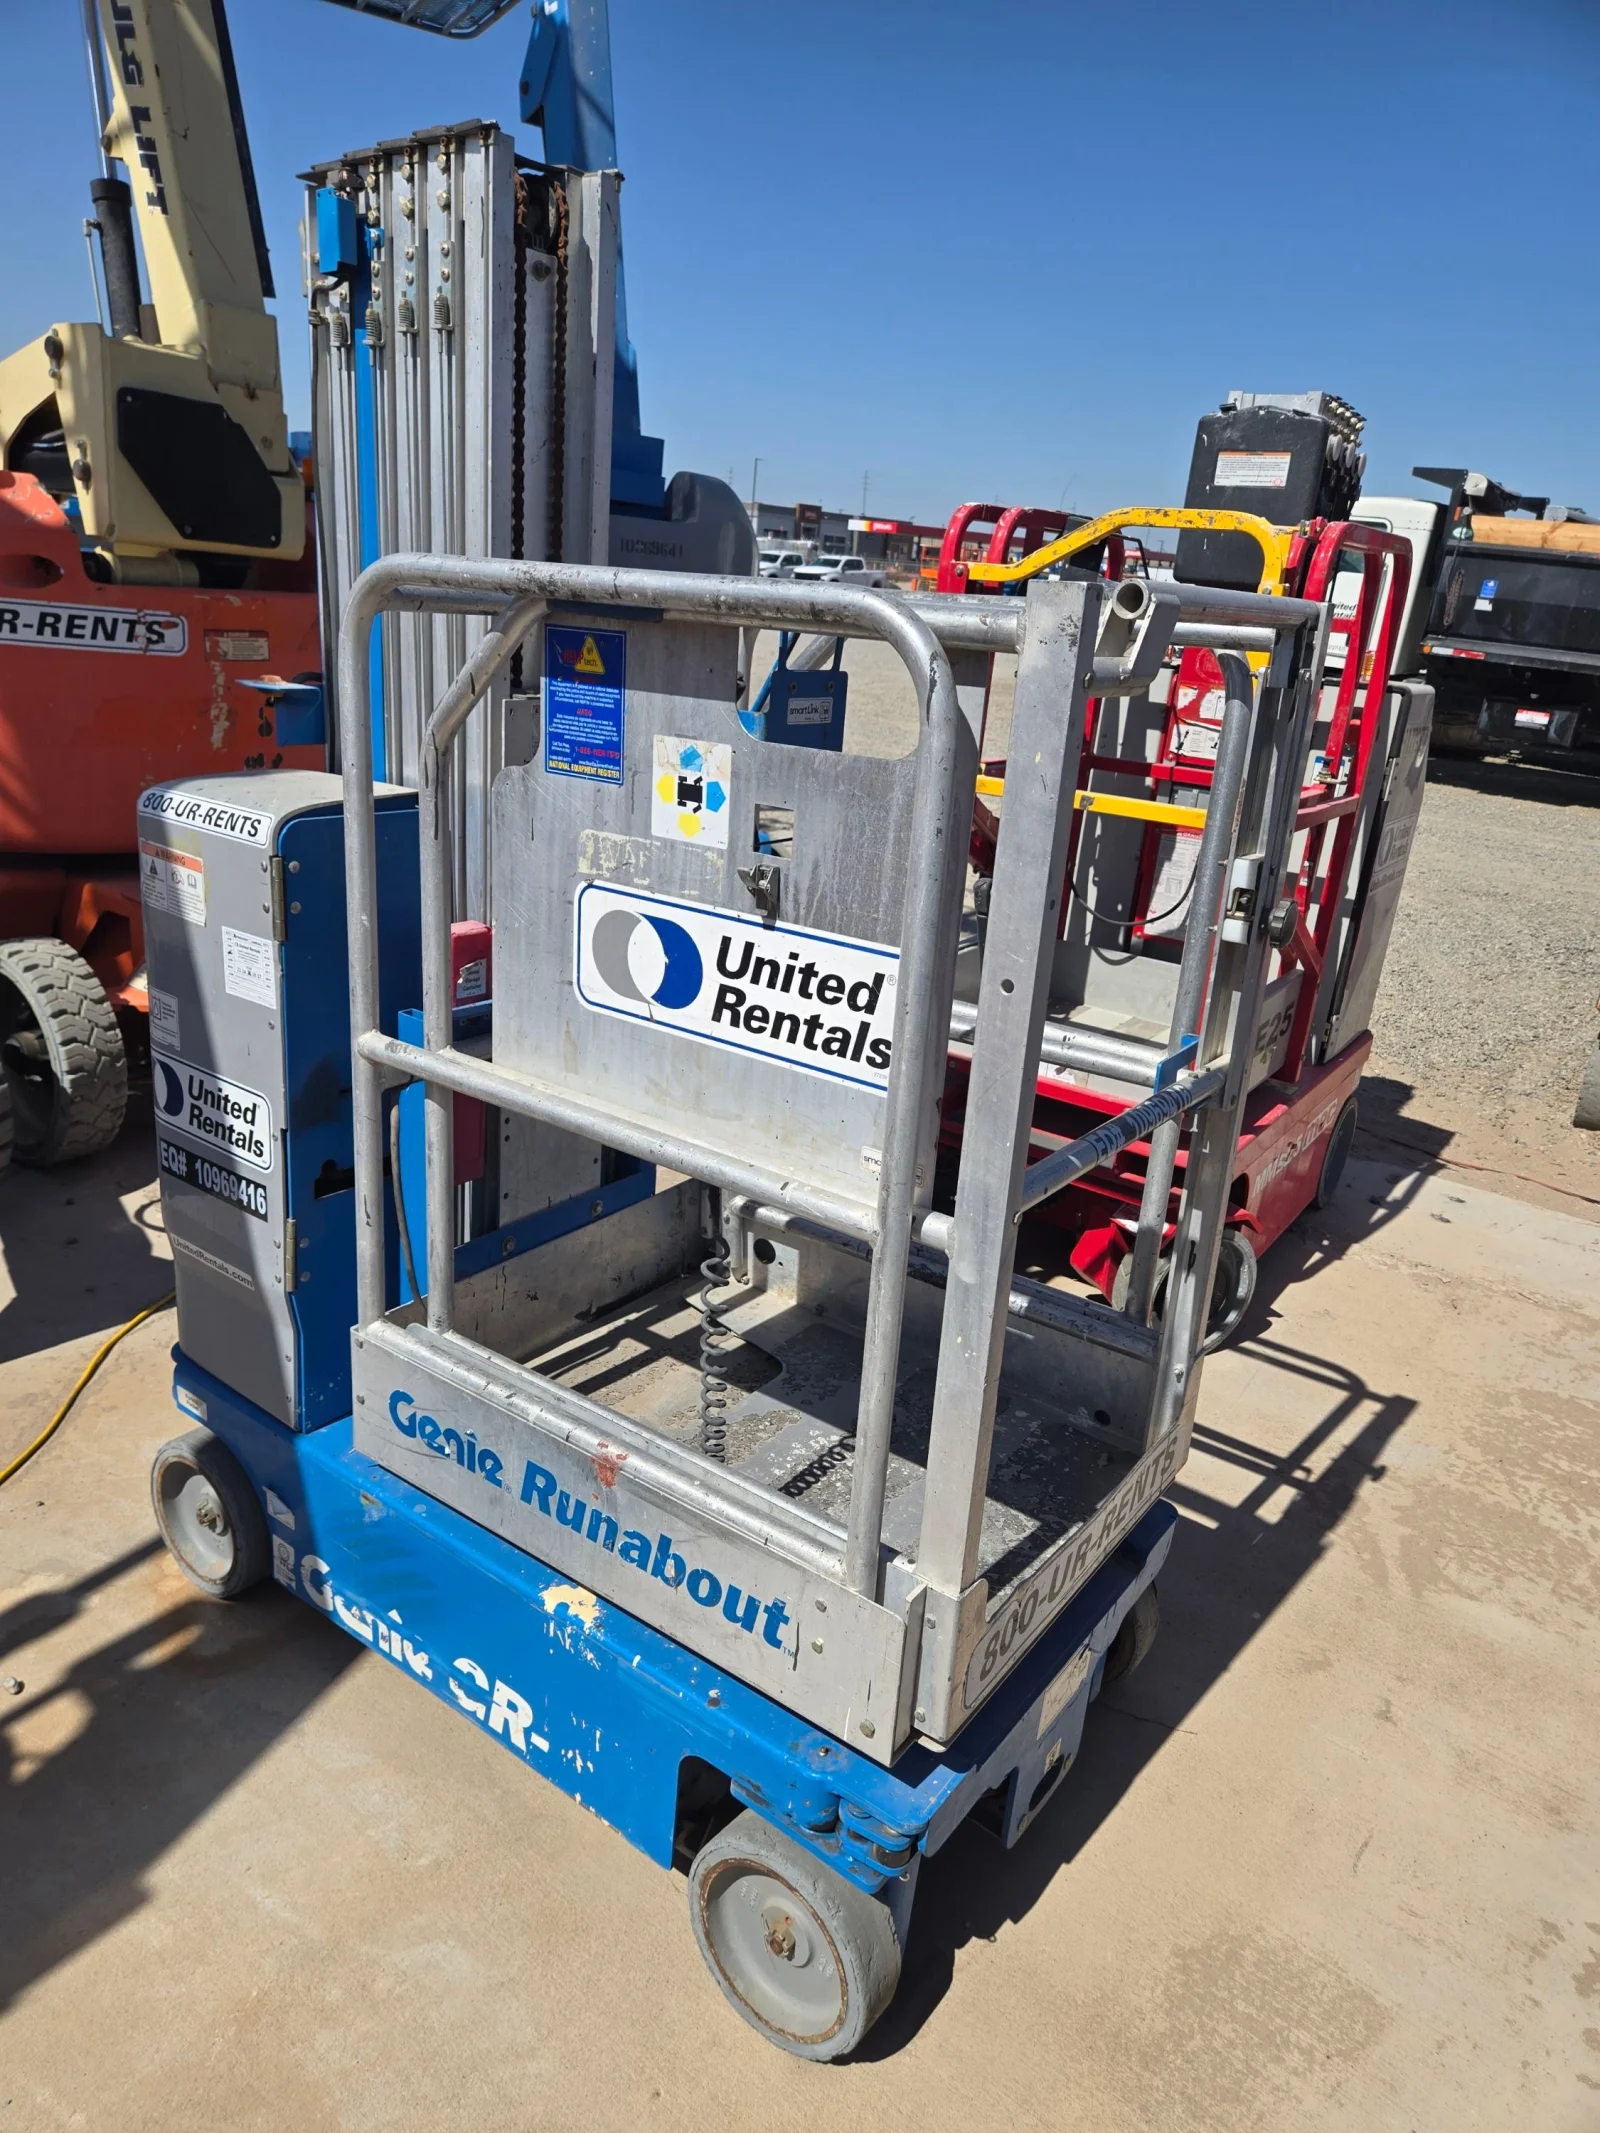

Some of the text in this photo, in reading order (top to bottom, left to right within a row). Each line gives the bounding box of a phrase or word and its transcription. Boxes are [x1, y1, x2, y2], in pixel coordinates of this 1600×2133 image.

[130, 105, 169, 216] LIFT
[549, 760, 571, 771] NATIONAL
[571, 763, 597, 775] EQUIPMENT
[598, 767, 620, 779] REGISTER
[142, 792, 262, 838] 800-UR-RENTS
[716, 935, 886, 1016] United
[711, 983, 893, 1070] Rentals
[188, 1075, 258, 1127] United
[188, 1103, 264, 1159] Rentals
[160, 1140, 268, 1215] EQ# 10969416
[172, 1237, 253, 1288] UnitedRentals.com
[388, 1390, 790, 1650] Genie Runabout
[980, 1435, 1178, 1682] 800-UR-RENTS
